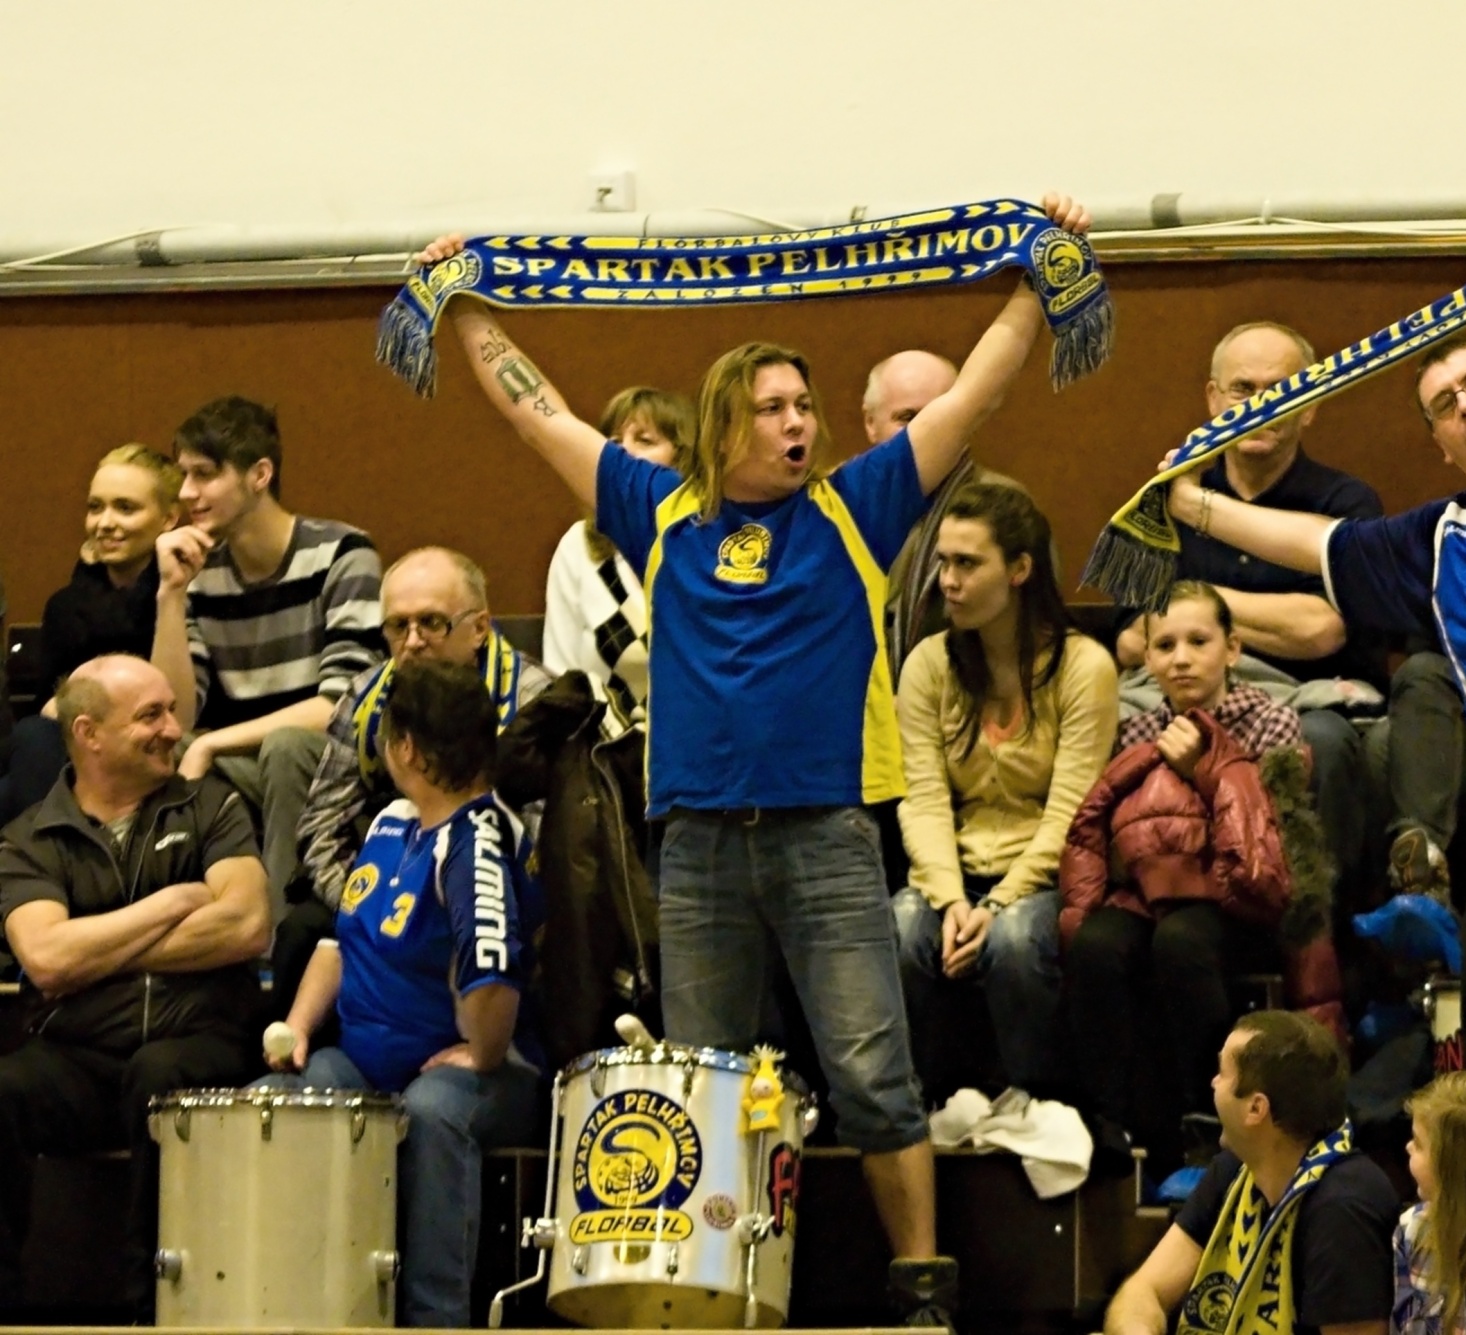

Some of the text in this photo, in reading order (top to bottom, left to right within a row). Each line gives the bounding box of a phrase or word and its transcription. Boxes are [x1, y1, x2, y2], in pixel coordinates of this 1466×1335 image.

[493, 255, 736, 282] SPARTAK
[747, 222, 1036, 278] PELHŘIMOV
[839, 272, 921, 289] 1999
[379, 892, 416, 937] 3
[468, 808, 507, 971] SALMING
[575, 1099, 618, 1191] SPARTAK
